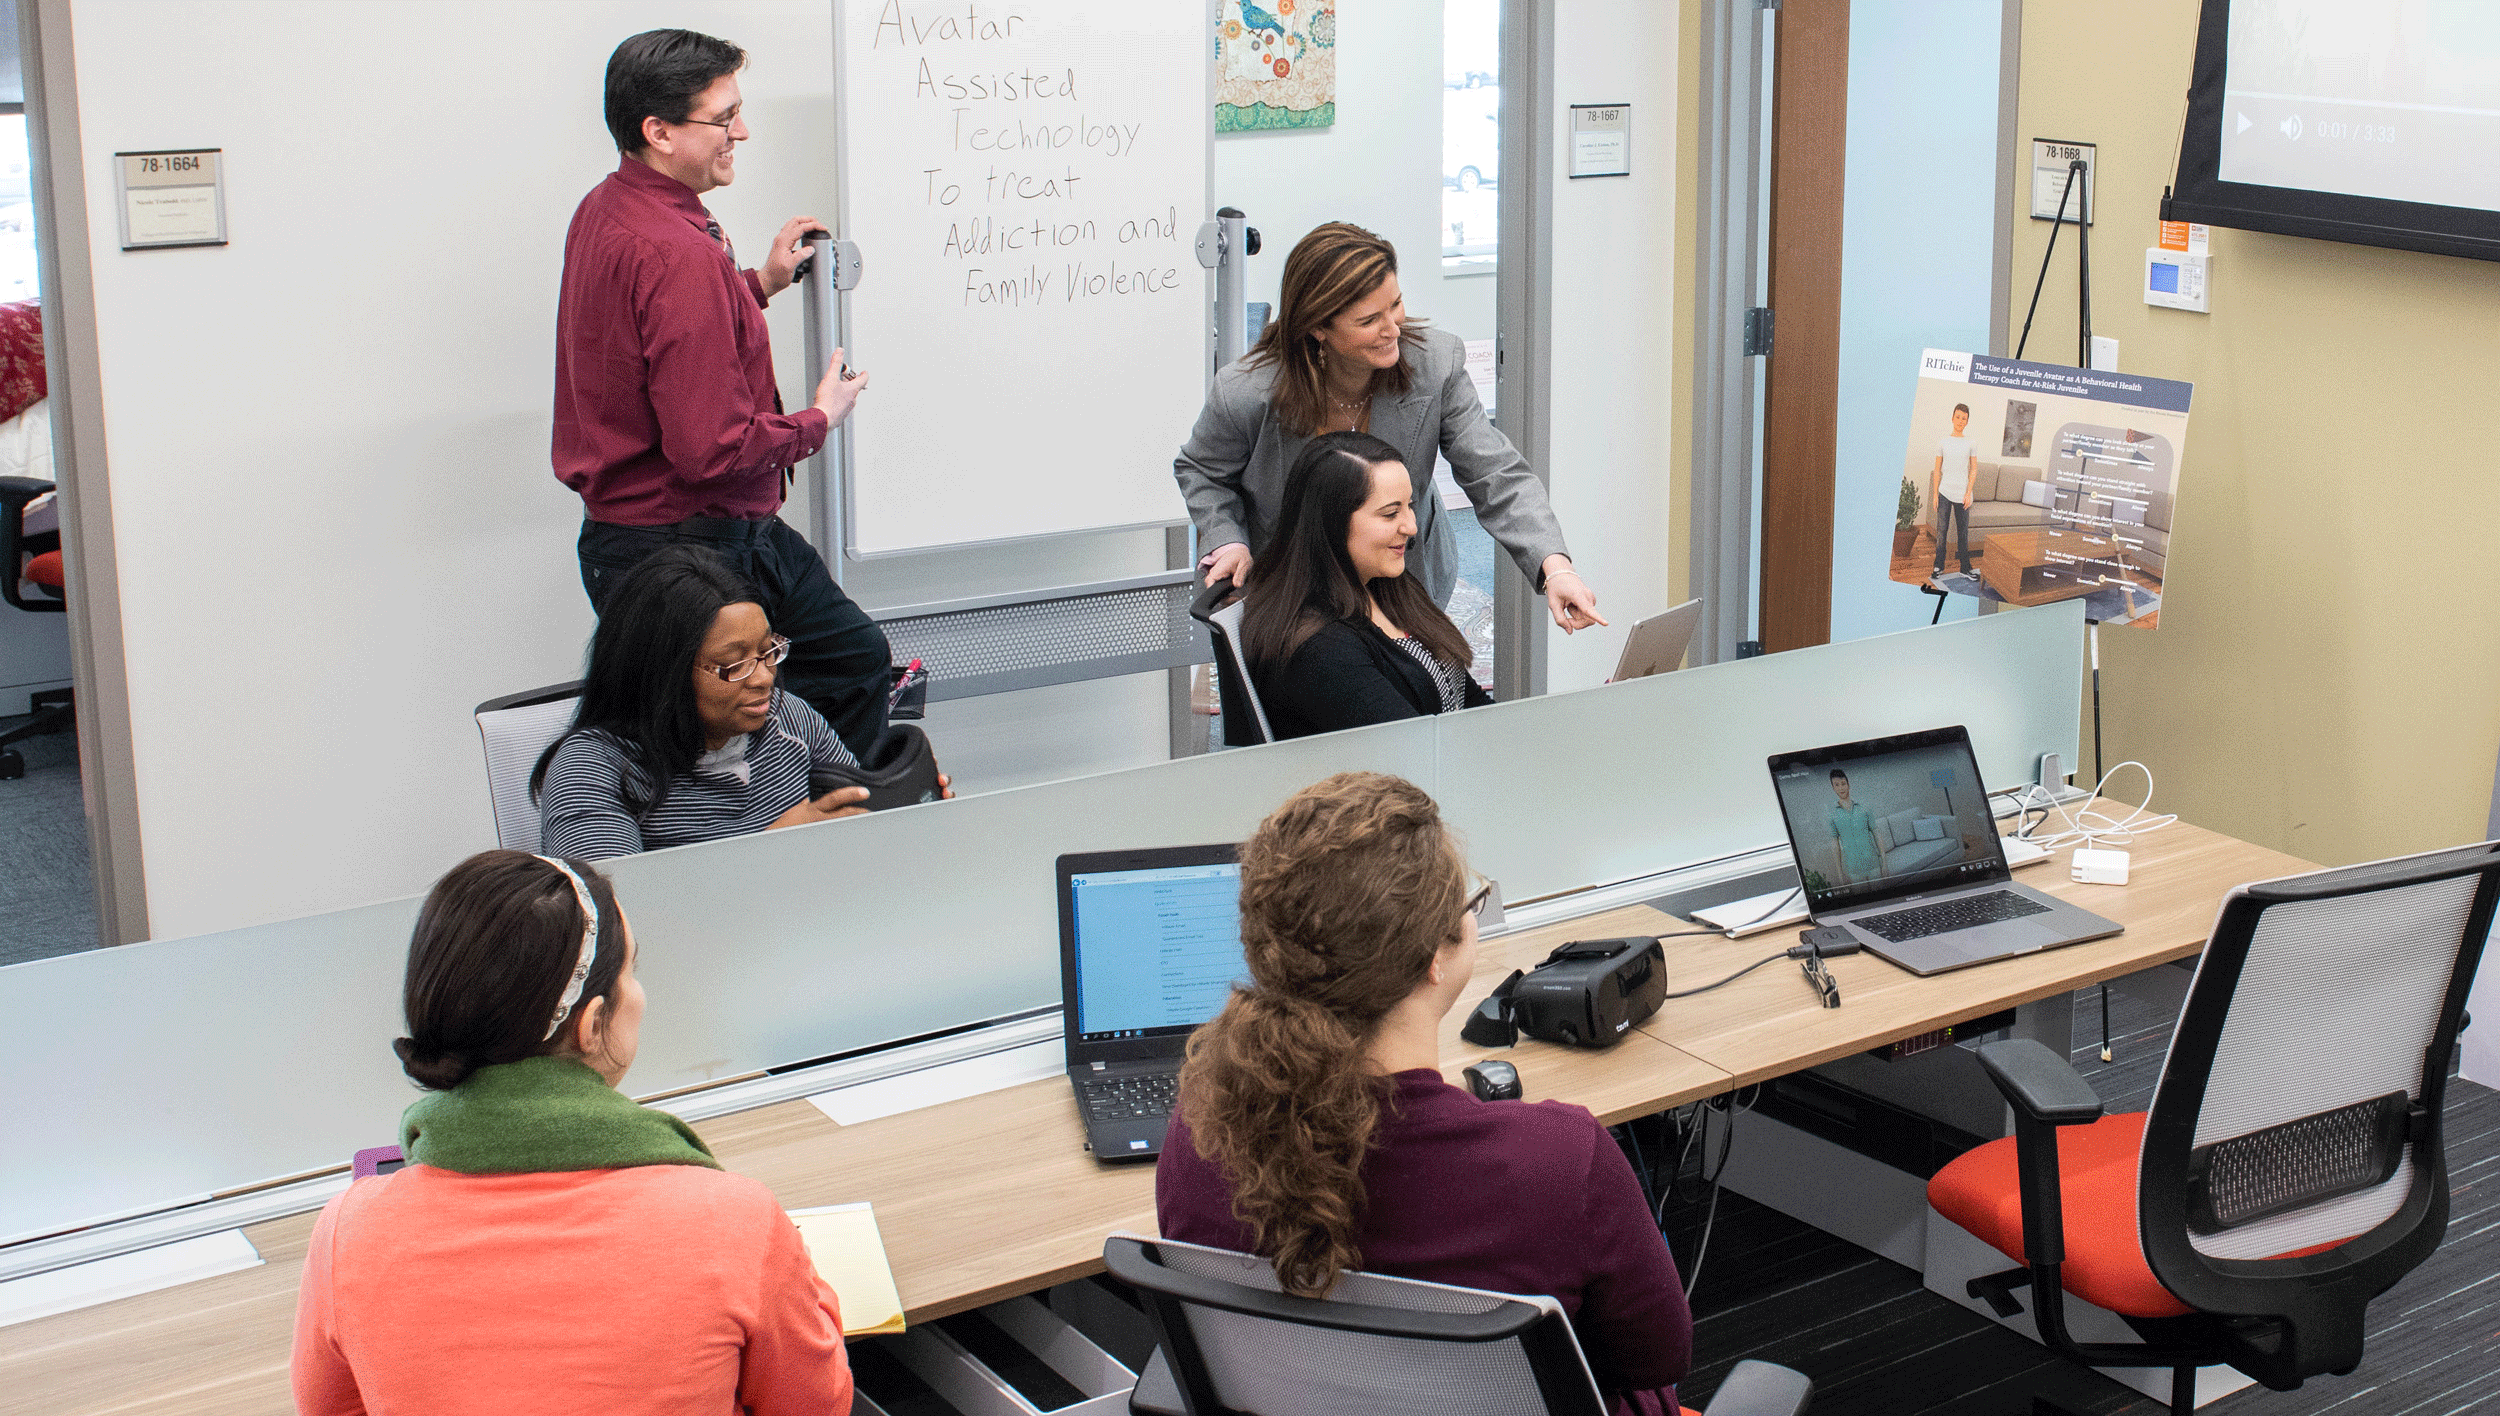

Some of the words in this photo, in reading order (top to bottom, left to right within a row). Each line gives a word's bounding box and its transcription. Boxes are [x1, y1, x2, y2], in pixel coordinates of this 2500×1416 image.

[873, 0, 1024, 50] Avatar
[917, 56, 1077, 101] Assisted
[1587, 110, 1619, 121] 78-1667
[951, 107, 1141, 157] Technology
[2317, 120, 2348, 140] 0:01
[2364, 125, 2396, 144] 3:33
[140, 156, 200, 172] 78-1664
[2046, 145, 2080, 160] 78-1668
[923, 169, 961, 206] To
[987, 165, 1081, 202] treat
[944, 216, 1096, 259] Addiction
[1119, 206, 1177, 243] and
[965, 264, 1051, 307] Family
[1067, 260, 1180, 303] Violence
[1925, 356, 1965, 372] RITchie
[1973, 372, 1999, 383] Therapy
[2000, 376, 2020, 385] Coach
[2021, 378, 2031, 386] for
[2031, 380, 2056, 390] At-Risk
[2056, 383, 2088, 394] Juveniles
[1974, 363, 1987, 371] The
[1988, 365, 2000, 373] Use
[2001, 366, 2009, 374] of
[2014, 368, 2042, 378] Juvenile
[2043, 371, 2065, 381] Avatar
[2081, 376, 2117, 388] Behavioral
[2118, 381, 2143, 392] Health
[2131, 504, 2147, 512] Always
[2082, 536, 2106, 544] Sometimes
[2125, 543, 2141, 551] Always
[2076, 577, 2100, 585] Sometimes
